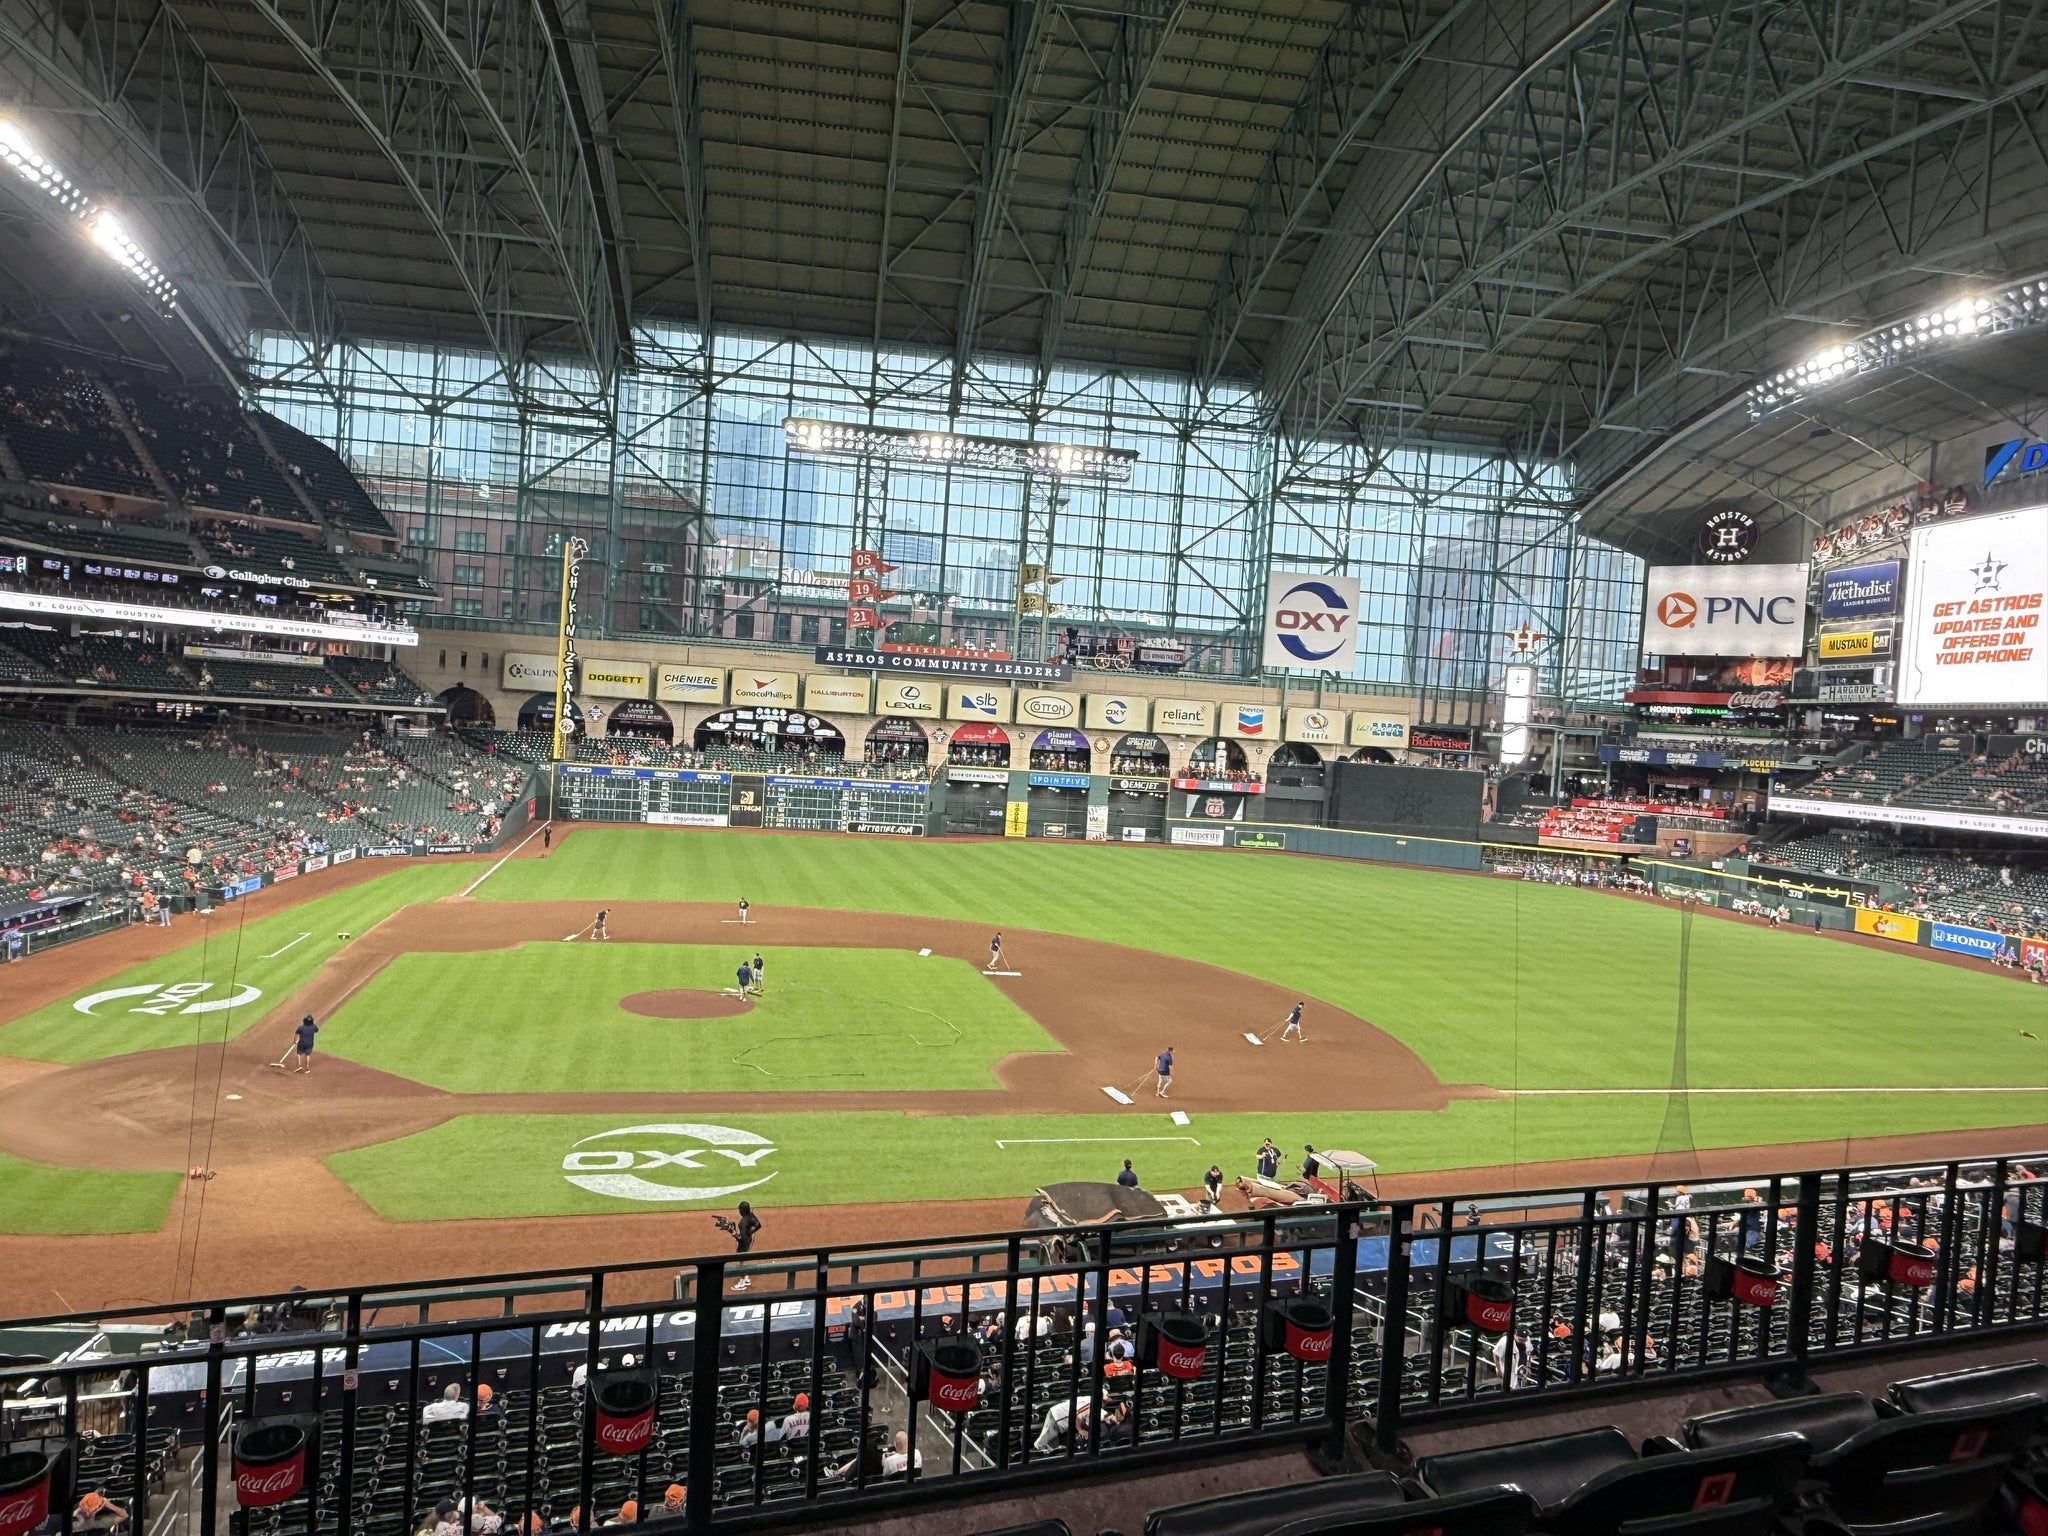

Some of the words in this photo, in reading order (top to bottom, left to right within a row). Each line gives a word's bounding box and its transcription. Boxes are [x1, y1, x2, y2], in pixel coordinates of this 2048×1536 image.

[1706, 511, 1754, 528] HOUSTON
[1717, 528, 1740, 546] H
[856, 554, 871, 566] 05
[1706, 547, 1748, 561] ASTROS
[228, 570, 283, 585] Gallagher
[284, 576, 310, 588] Club
[1026, 568, 1040, 579] 17
[856, 584, 870, 595] 19
[1828, 579, 1892, 602] Methodist
[565, 565, 579, 637] CHIKIN
[1023, 598, 1038, 608] 22
[1933, 601, 1966, 617] GET
[1967, 593, 2043, 615] ASTROS
[115, 609, 164, 619] HOUSTON
[853, 611, 867, 622] 21
[1703, 596, 1795, 625] PNC
[1275, 609, 1350, 633] OXY
[1933, 617, 2003, 635] UPDATES
[2003, 614, 2039, 629] AND
[1829, 638, 1868, 651] MUSTANG
[1873, 635, 1890, 648] CAT
[1942, 633, 2000, 649] OFFERS
[2001, 631, 2026, 646] ON
[896, 645, 946, 655] DAIKIN
[956, 649, 990, 658] PARK
[1935, 651, 1975, 665] YOUR
[1974, 648, 2033, 663] PHONE!
[826, 652, 885, 665] ASTROS
[892, 656, 989, 673] COMMUNITY
[995, 664, 1062, 678] LEADERS
[523, 667, 558, 678] CALPIN
[588, 673, 643, 684] DOGGETT
[664, 674, 718, 686] CHENIERE
[562, 667, 574, 717] FAIR
[736, 688, 793, 700] ConocoPhillips
[810, 689, 864, 698] HALLIBURTON
[1829, 685, 1878, 702] HARGROVE
[885, 701, 932, 710] LEXUS
[976, 693, 998, 707] slb
[1030, 701, 1066, 716] COTTON
[1163, 708, 1202, 721] reliant
[1411, 735, 1471, 750] Budweiser
[1741, 759, 1779, 768] PLUCKERS
[1033, 775, 1087, 786] 1POINTFIVE
[1128, 781, 1160, 791] EMCJET
[732, 804, 761, 812] BETMGM
[1600, 801, 1647, 812] Budweiser
[1562, 830, 1609, 842] Budweiser
[1788, 889, 1803, 899] 370
[129, 983, 214, 1015] OXY
[562, 1148, 779, 1170] OXY
